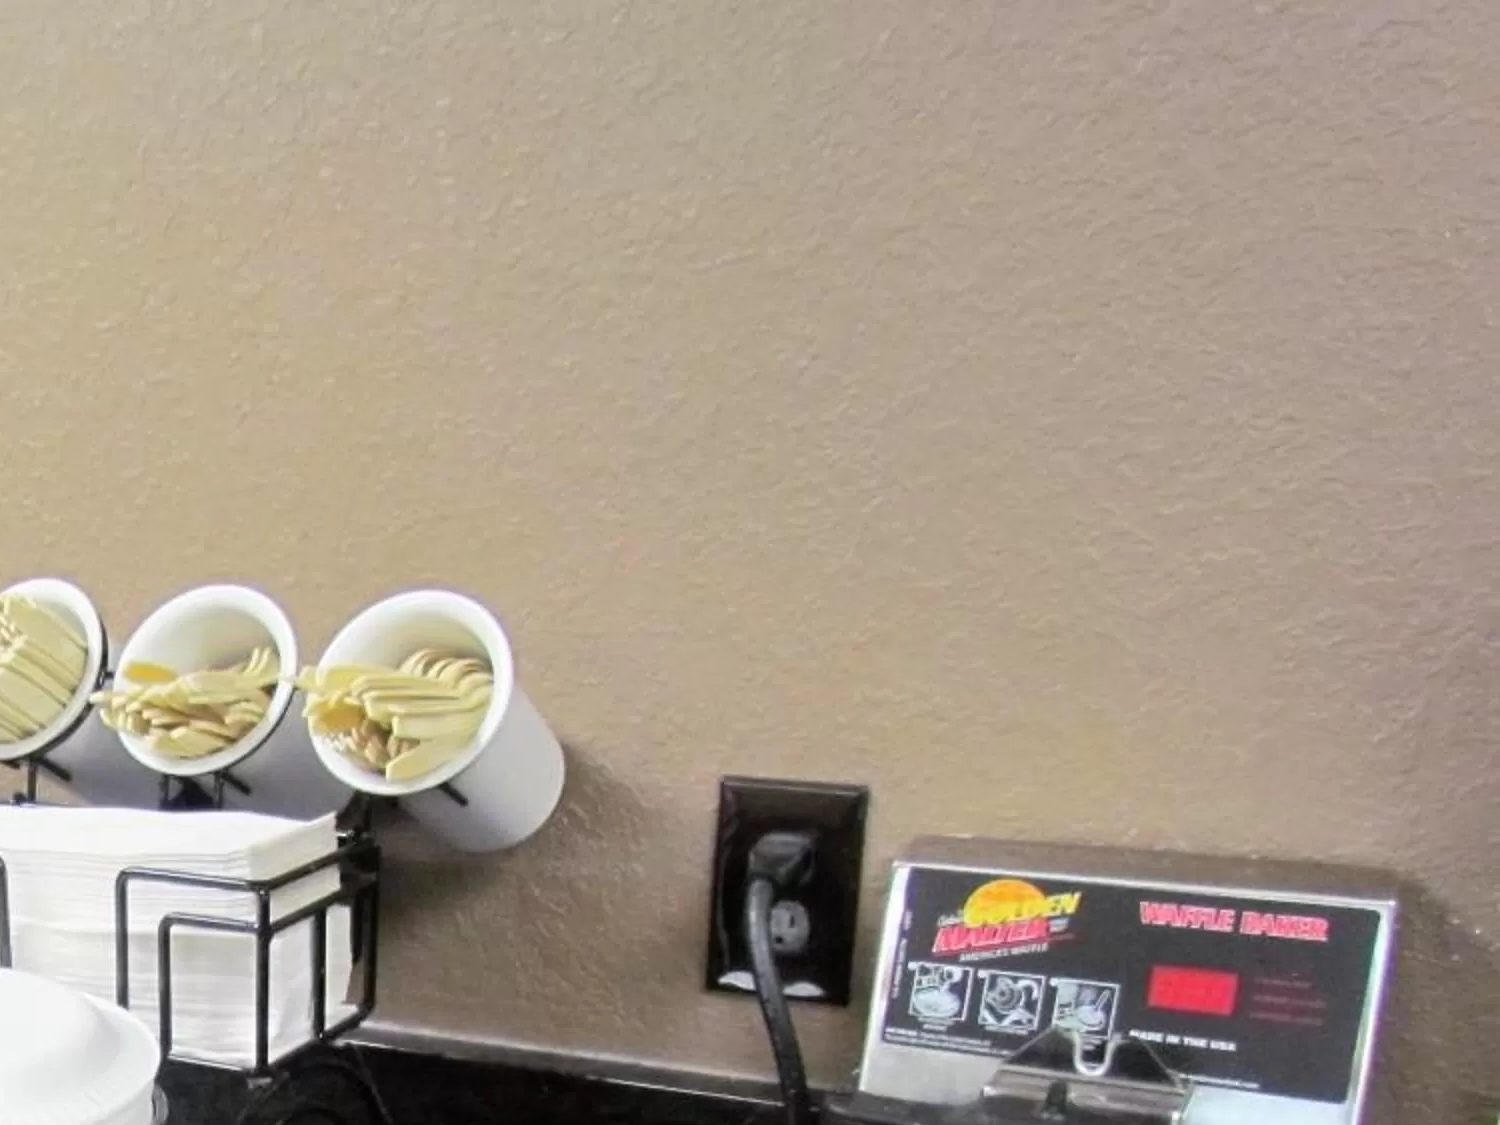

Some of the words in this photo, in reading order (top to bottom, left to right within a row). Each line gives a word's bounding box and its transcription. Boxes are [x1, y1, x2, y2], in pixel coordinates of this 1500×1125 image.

[1140, 901, 1236, 933] WAFFLE
[1240, 911, 1329, 942] BAKER
[1165, 1035, 1180, 1045] IN
[1183, 1036, 1208, 1048] THE
